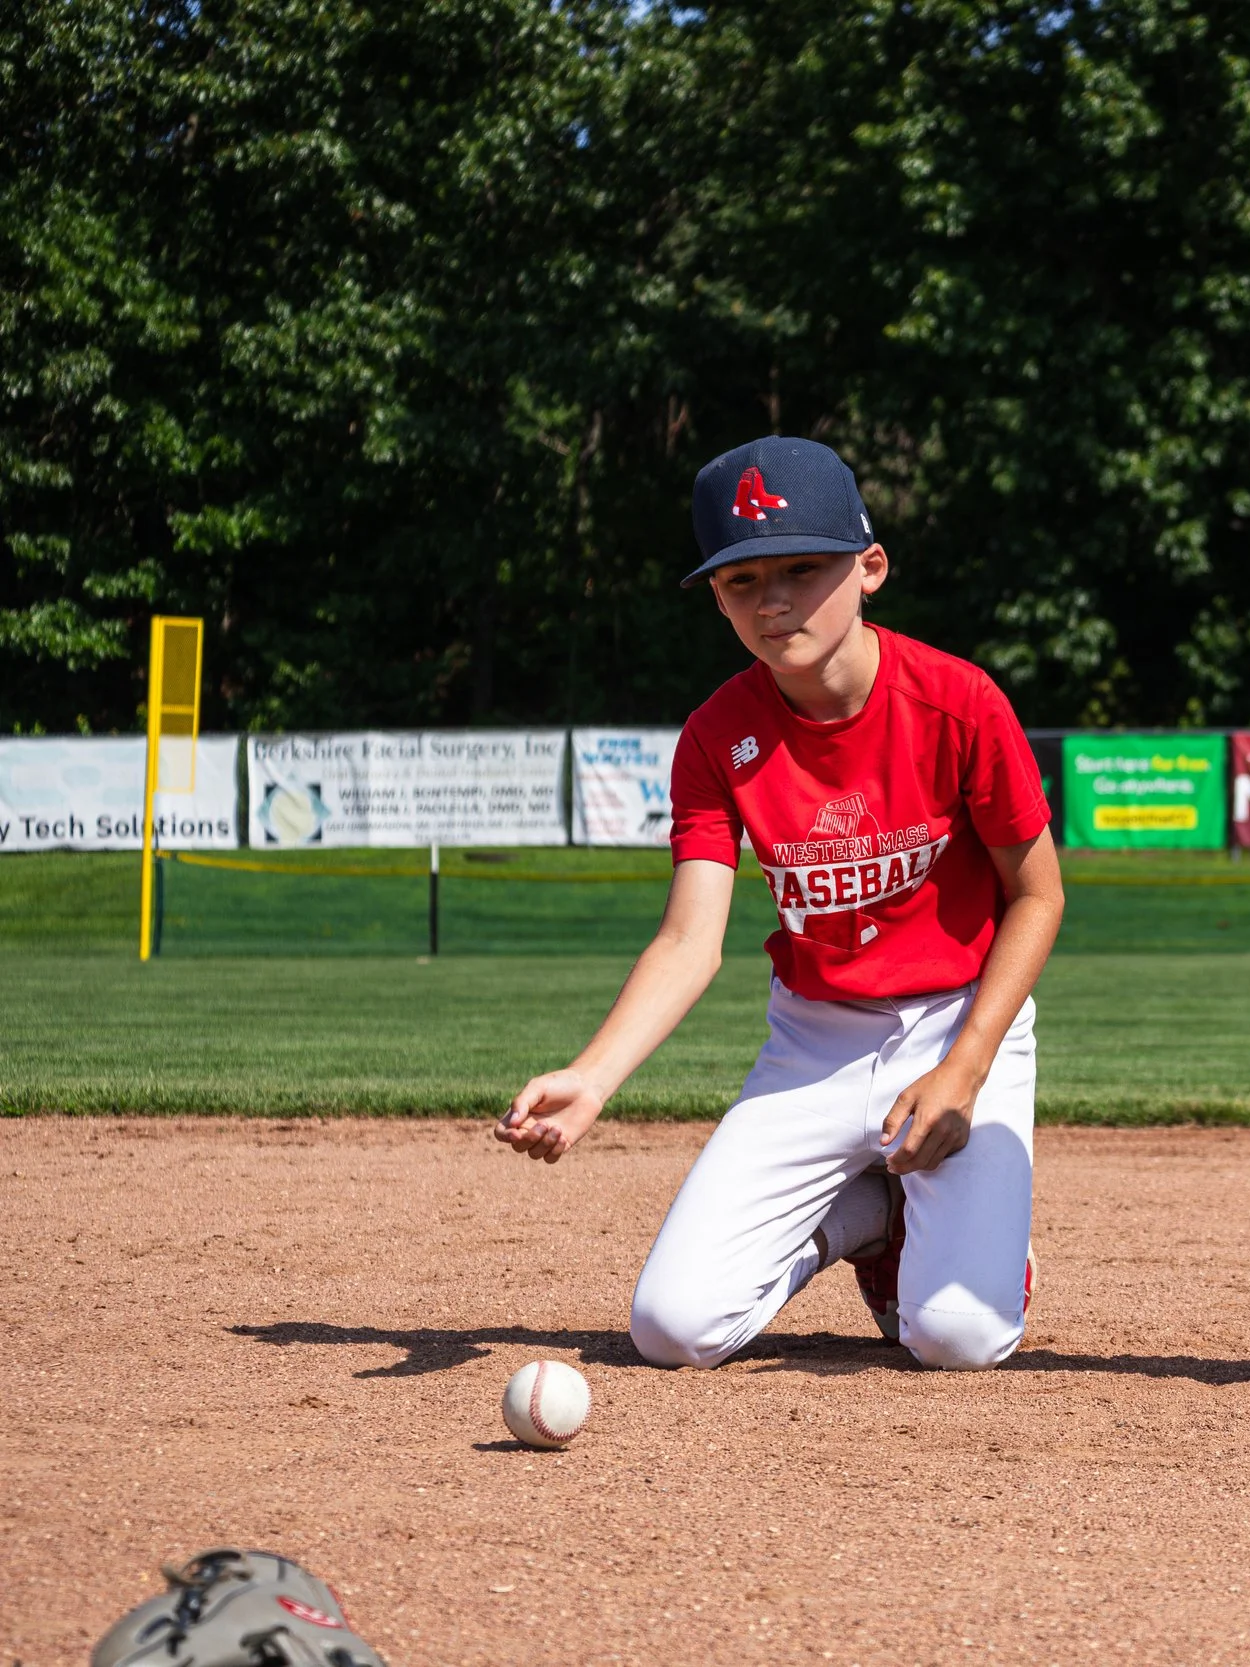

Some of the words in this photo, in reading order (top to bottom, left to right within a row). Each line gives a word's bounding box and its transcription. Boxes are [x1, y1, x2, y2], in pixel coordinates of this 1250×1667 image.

[361, 735, 423, 759] Facial
[19, 811, 84, 839] Tech
[773, 835, 873, 865] WESTERN
[877, 824, 930, 855] MASS
